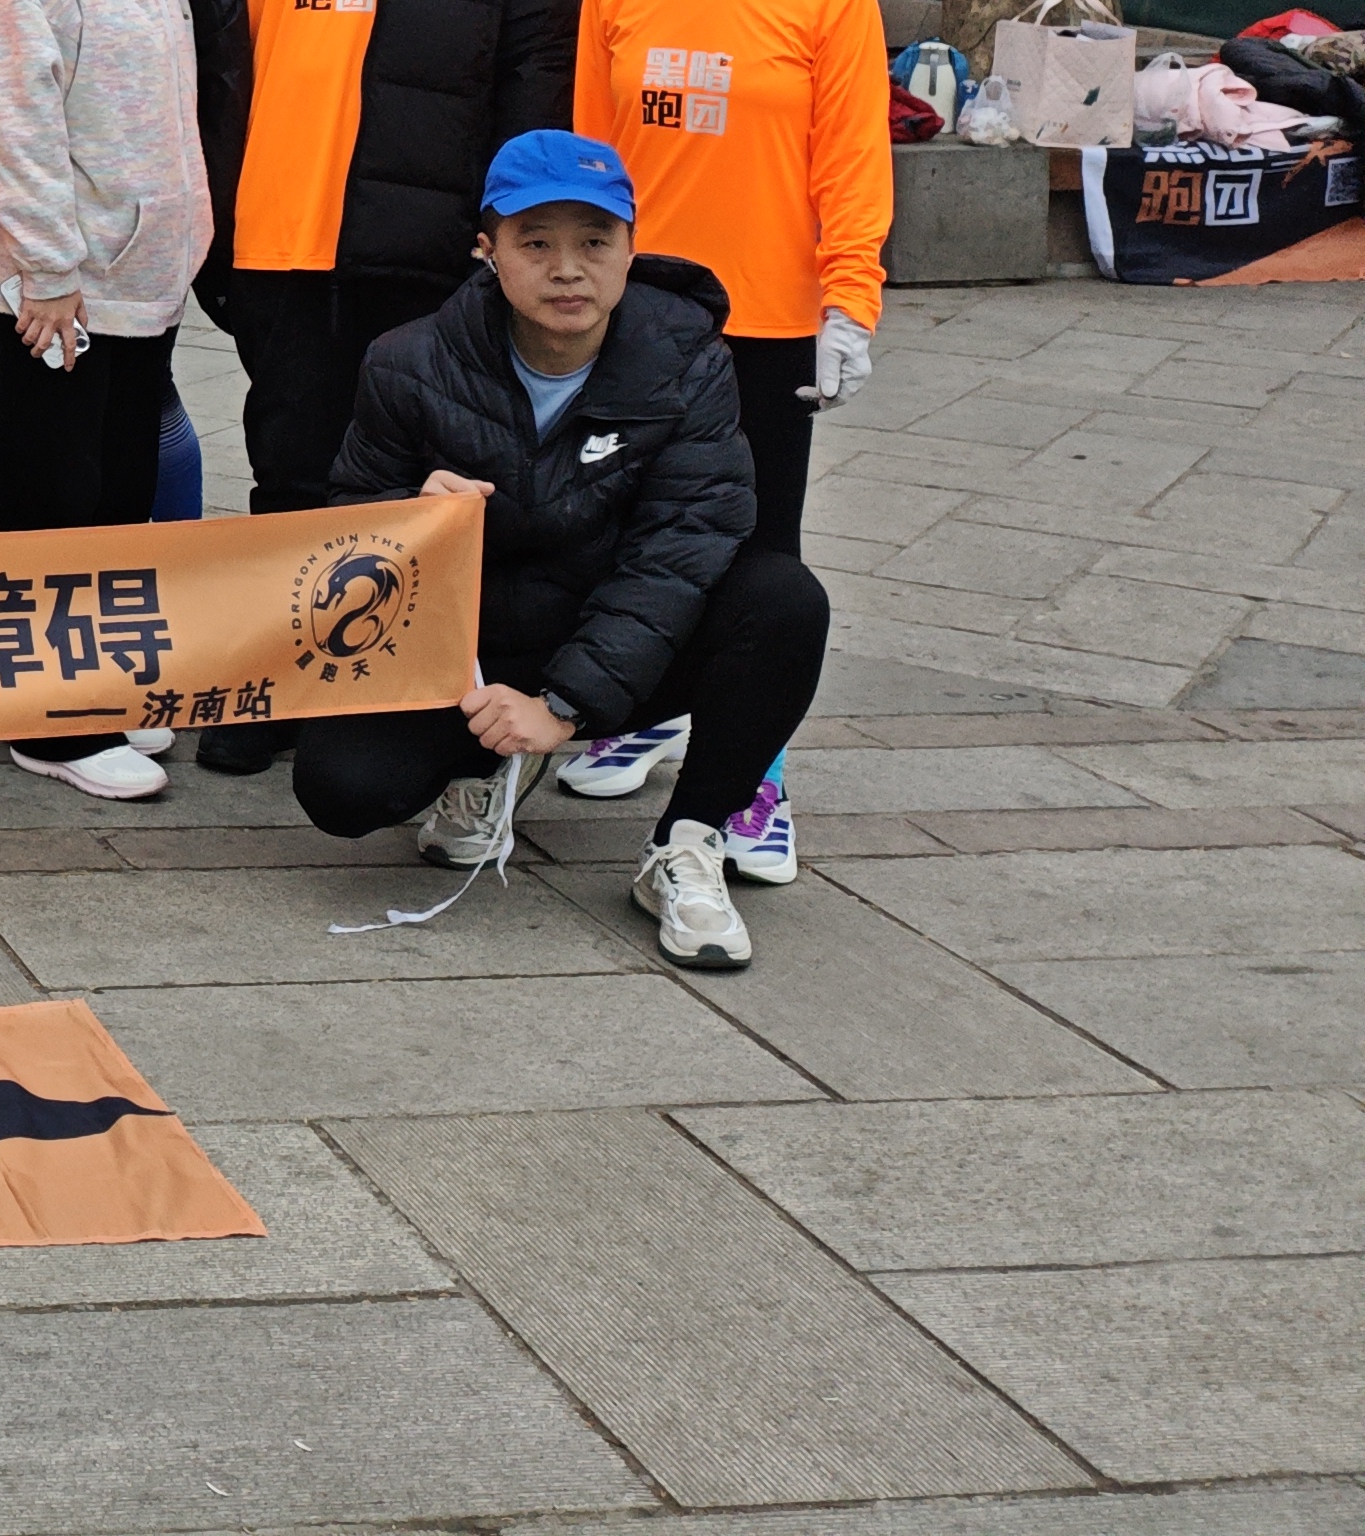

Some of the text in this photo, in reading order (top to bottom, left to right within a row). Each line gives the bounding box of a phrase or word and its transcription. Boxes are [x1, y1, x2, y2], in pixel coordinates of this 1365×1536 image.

[642, 48, 734, 94] 黑暗
[641, 89, 729, 137] 跑团
[1135, 168, 1263, 226] 跑团
[291, 533, 420, 630] DRAGON RUN THE WORLD
